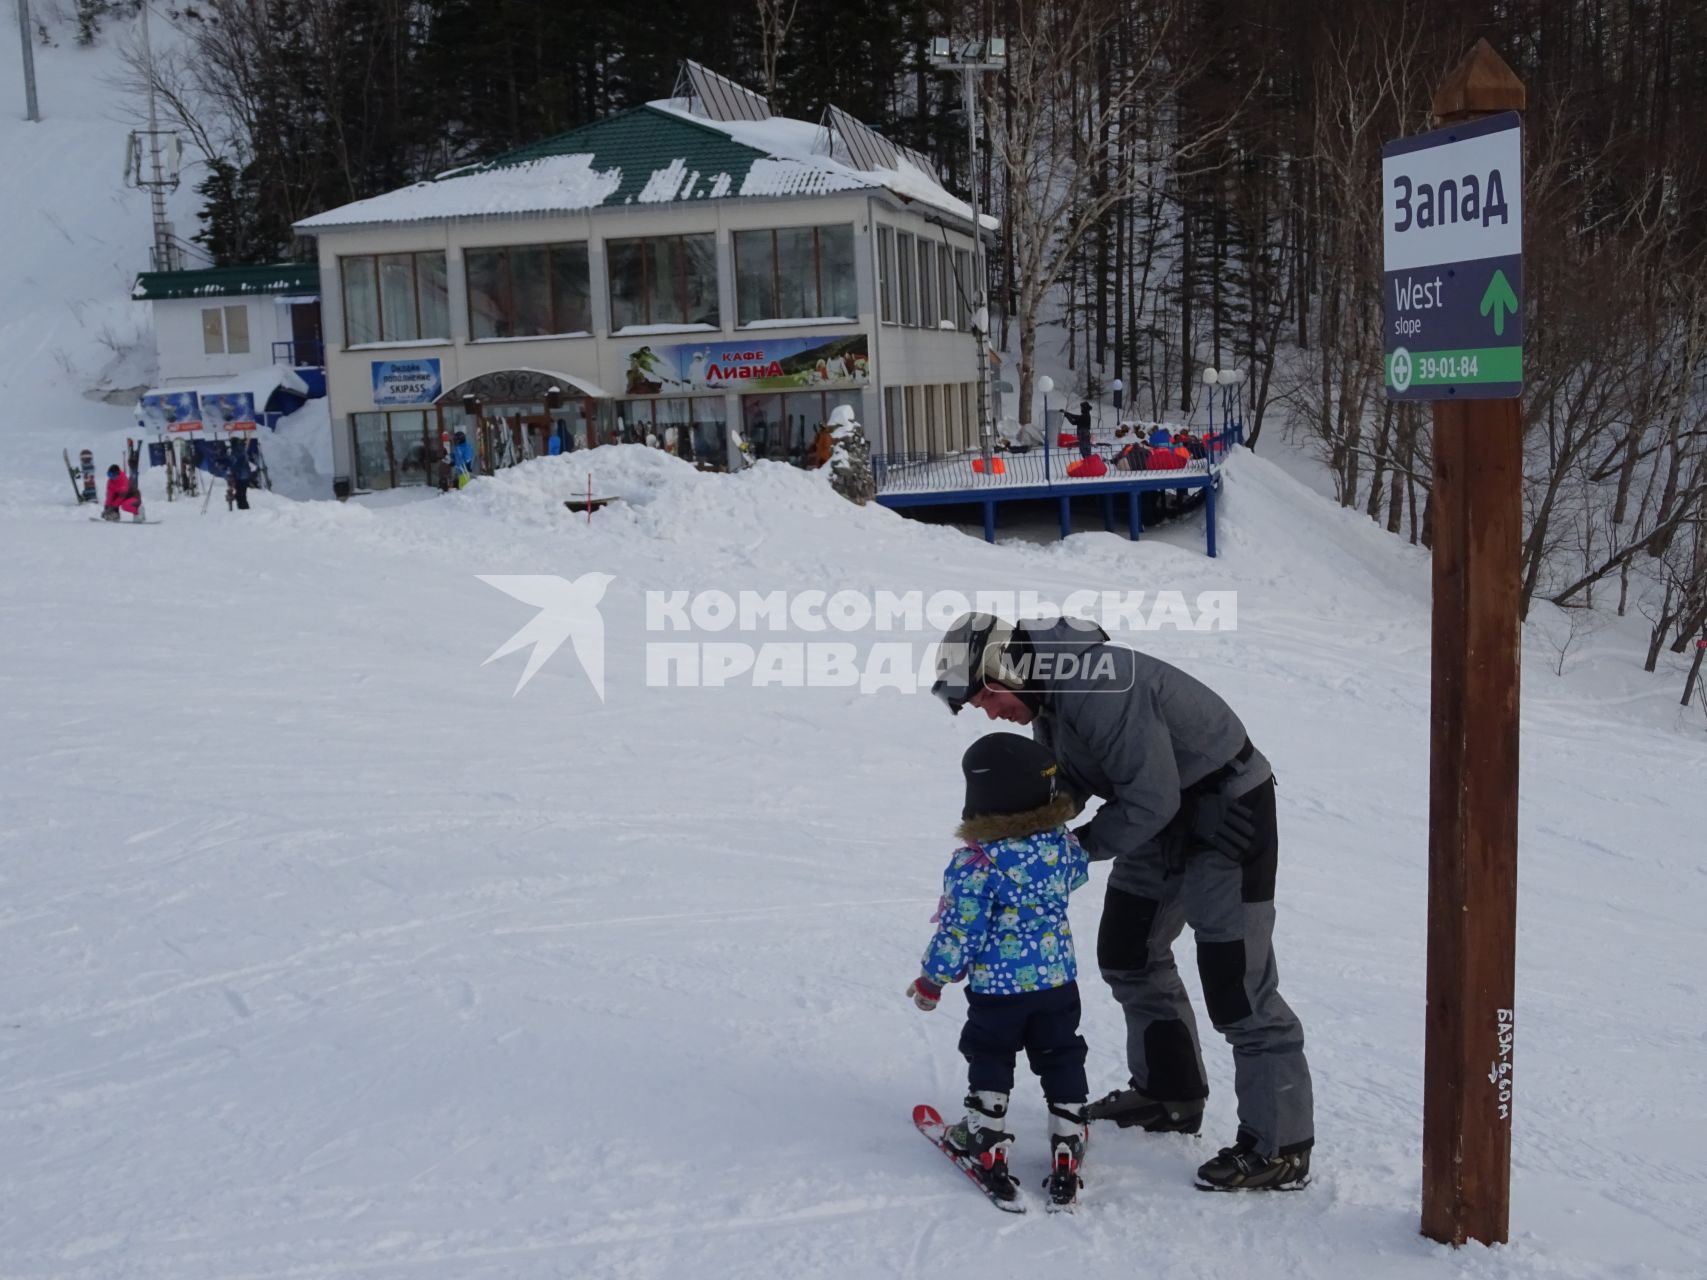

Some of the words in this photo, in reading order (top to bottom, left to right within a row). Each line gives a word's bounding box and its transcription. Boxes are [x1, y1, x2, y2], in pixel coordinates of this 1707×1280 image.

[1393, 168, 1509, 233] Запад
[1394, 275, 1443, 311] West
[1394, 316, 1422, 338] slope
[722, 351, 764, 361] КАФЕ
[1419, 355, 1479, 379] 39-01-84
[384, 374, 431, 382] пополнение
[390, 384, 426, 393] SKIPASS
